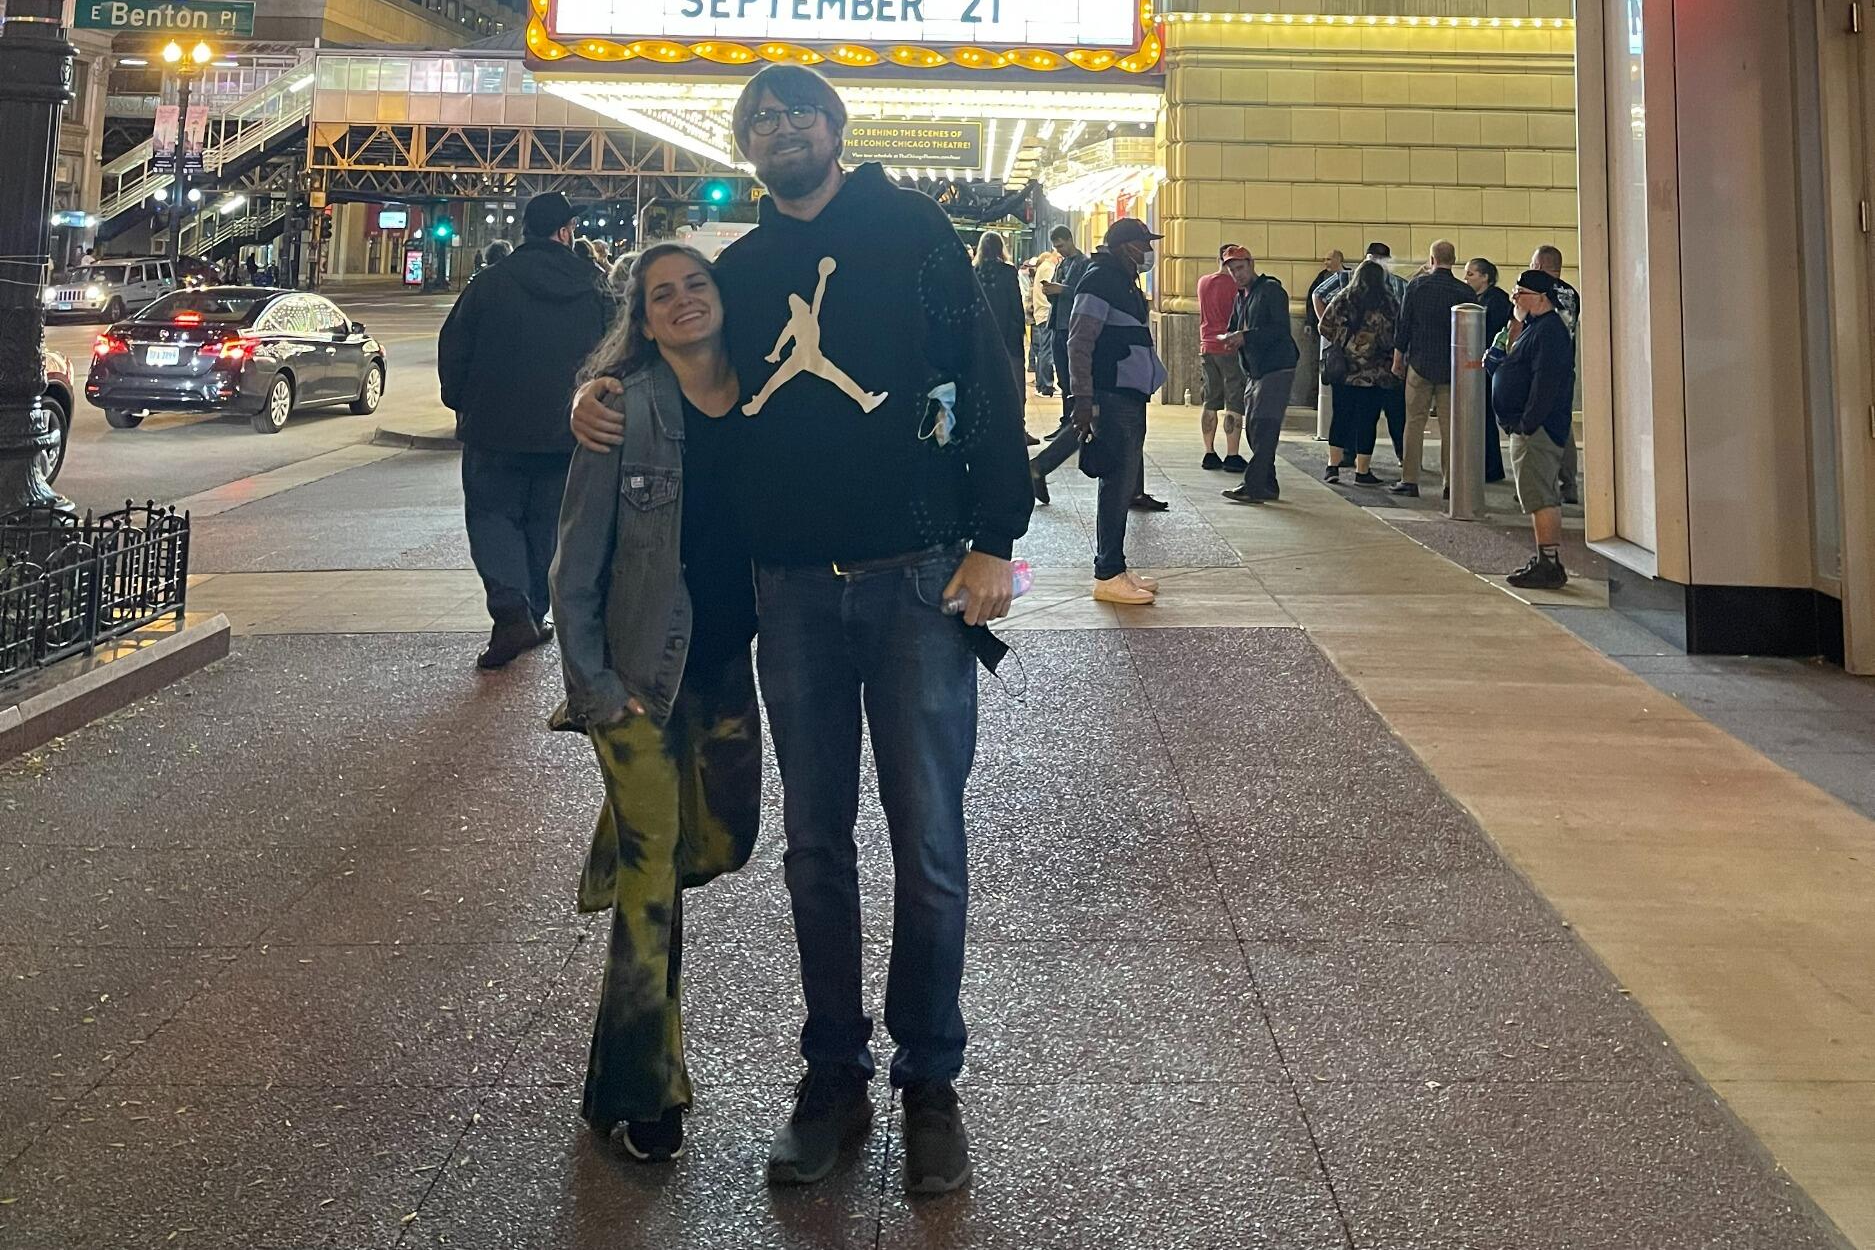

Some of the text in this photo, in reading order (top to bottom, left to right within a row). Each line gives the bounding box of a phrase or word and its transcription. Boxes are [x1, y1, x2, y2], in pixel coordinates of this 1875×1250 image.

[91, 2, 236, 29] E Benton Pl
[852, 128, 963, 138] GO BEHIND THE SCENES OF
[843, 139, 971, 149] THE ICONIC CHICAGO THEATRE!
